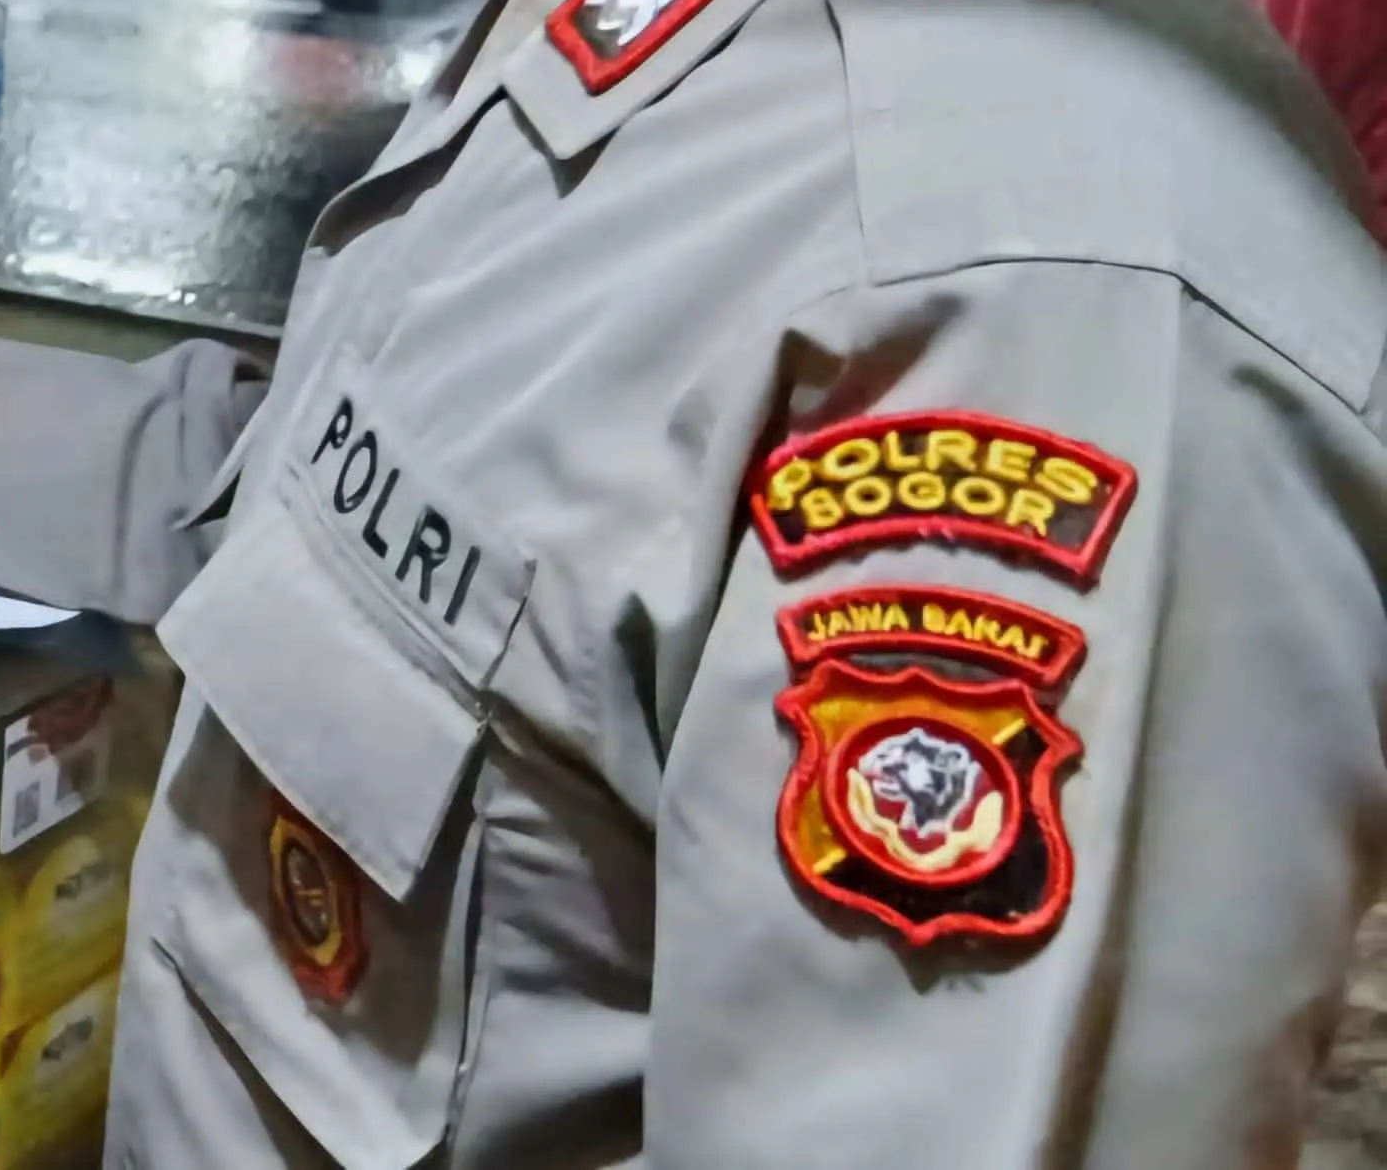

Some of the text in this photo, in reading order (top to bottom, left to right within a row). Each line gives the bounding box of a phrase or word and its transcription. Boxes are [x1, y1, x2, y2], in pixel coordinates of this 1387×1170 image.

[767, 429, 1098, 511] POLRES
[800, 472, 1056, 535] BOGOR
[310, 395, 481, 626] POLRI
[807, 603, 1049, 658] JAWA BARAT
